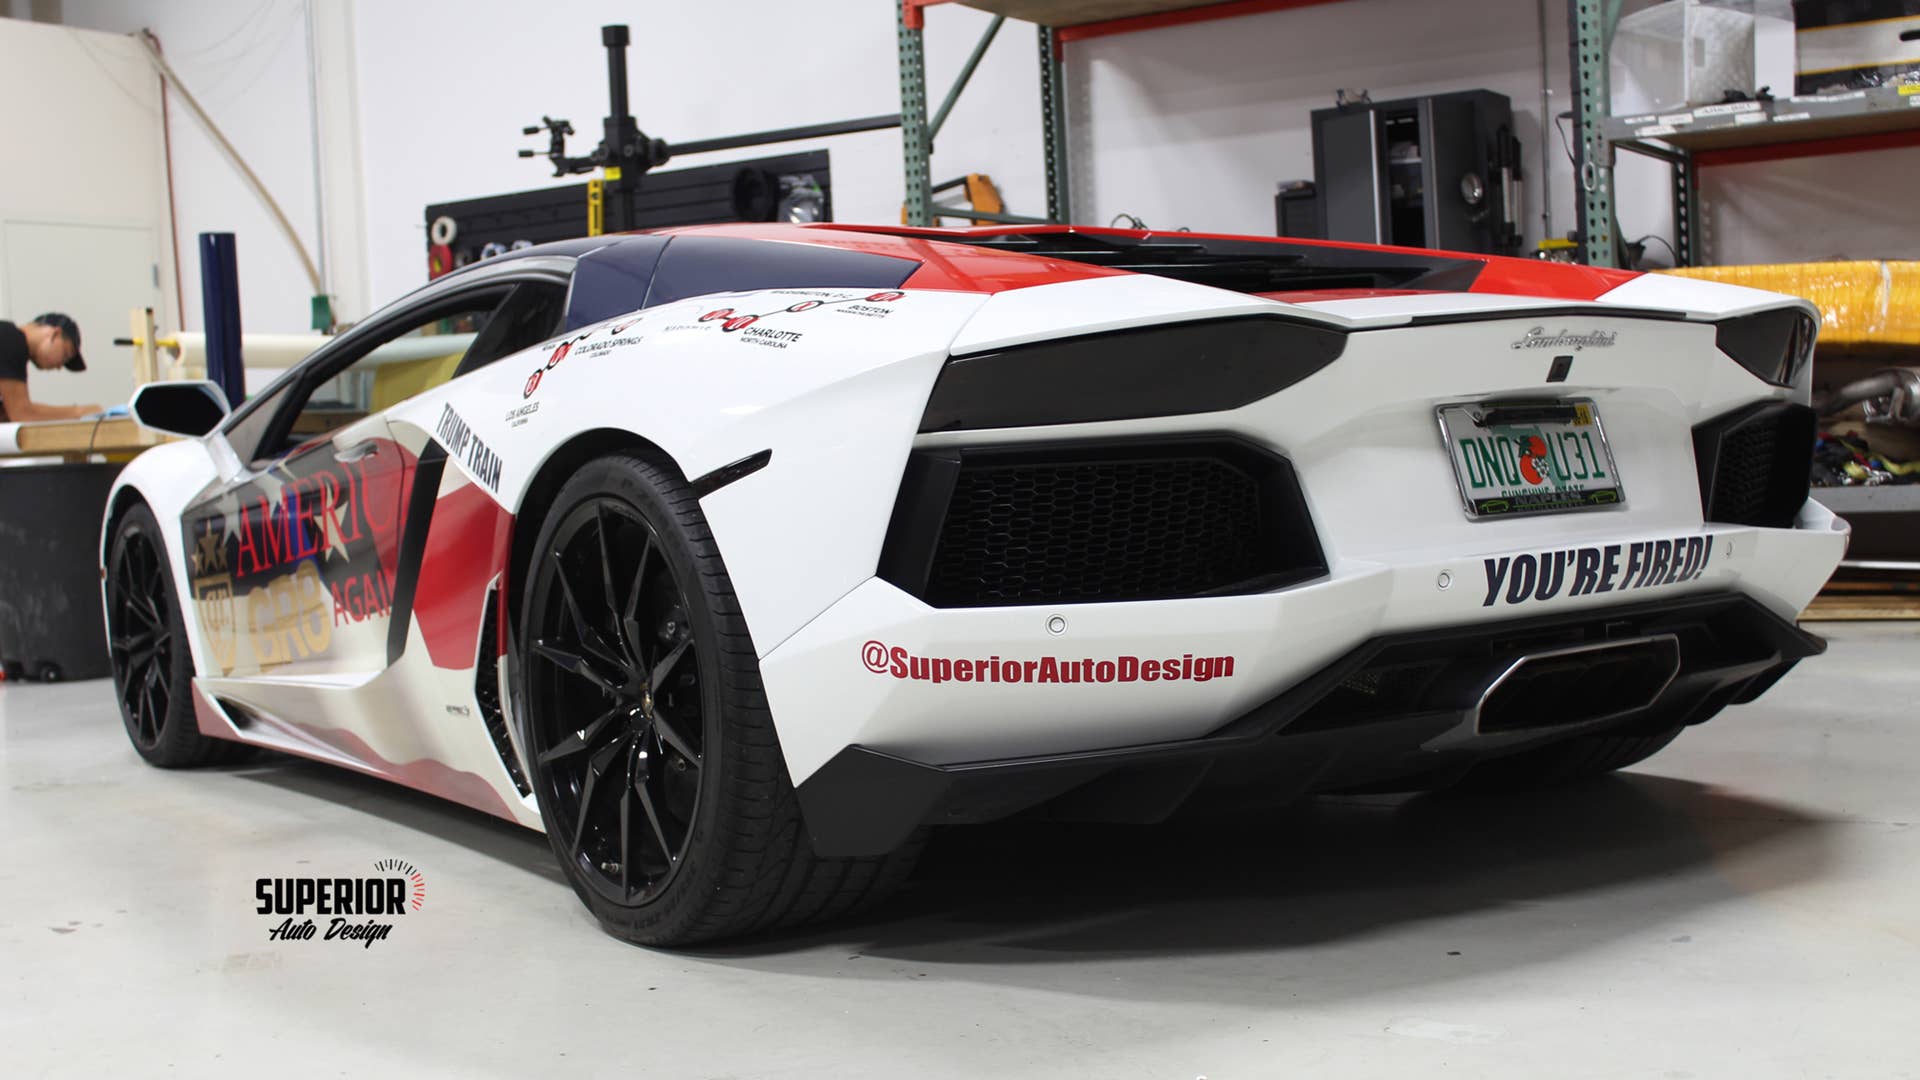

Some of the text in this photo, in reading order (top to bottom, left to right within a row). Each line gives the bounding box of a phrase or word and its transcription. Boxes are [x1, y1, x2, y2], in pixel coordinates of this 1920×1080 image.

[744, 327, 803, 342] CHARLOTTE
[1511, 326, 1618, 351] Lamborghini
[436, 402, 502, 494] TRUMP TRAIN
[1546, 432, 1606, 481] U31
[236, 456, 411, 577] AMERIC
[1482, 535, 1714, 607] YOU'RE FIRED!
[331, 570, 392, 628] AGAI
[861, 640, 1235, 684] @SuperiorAutoDesign
